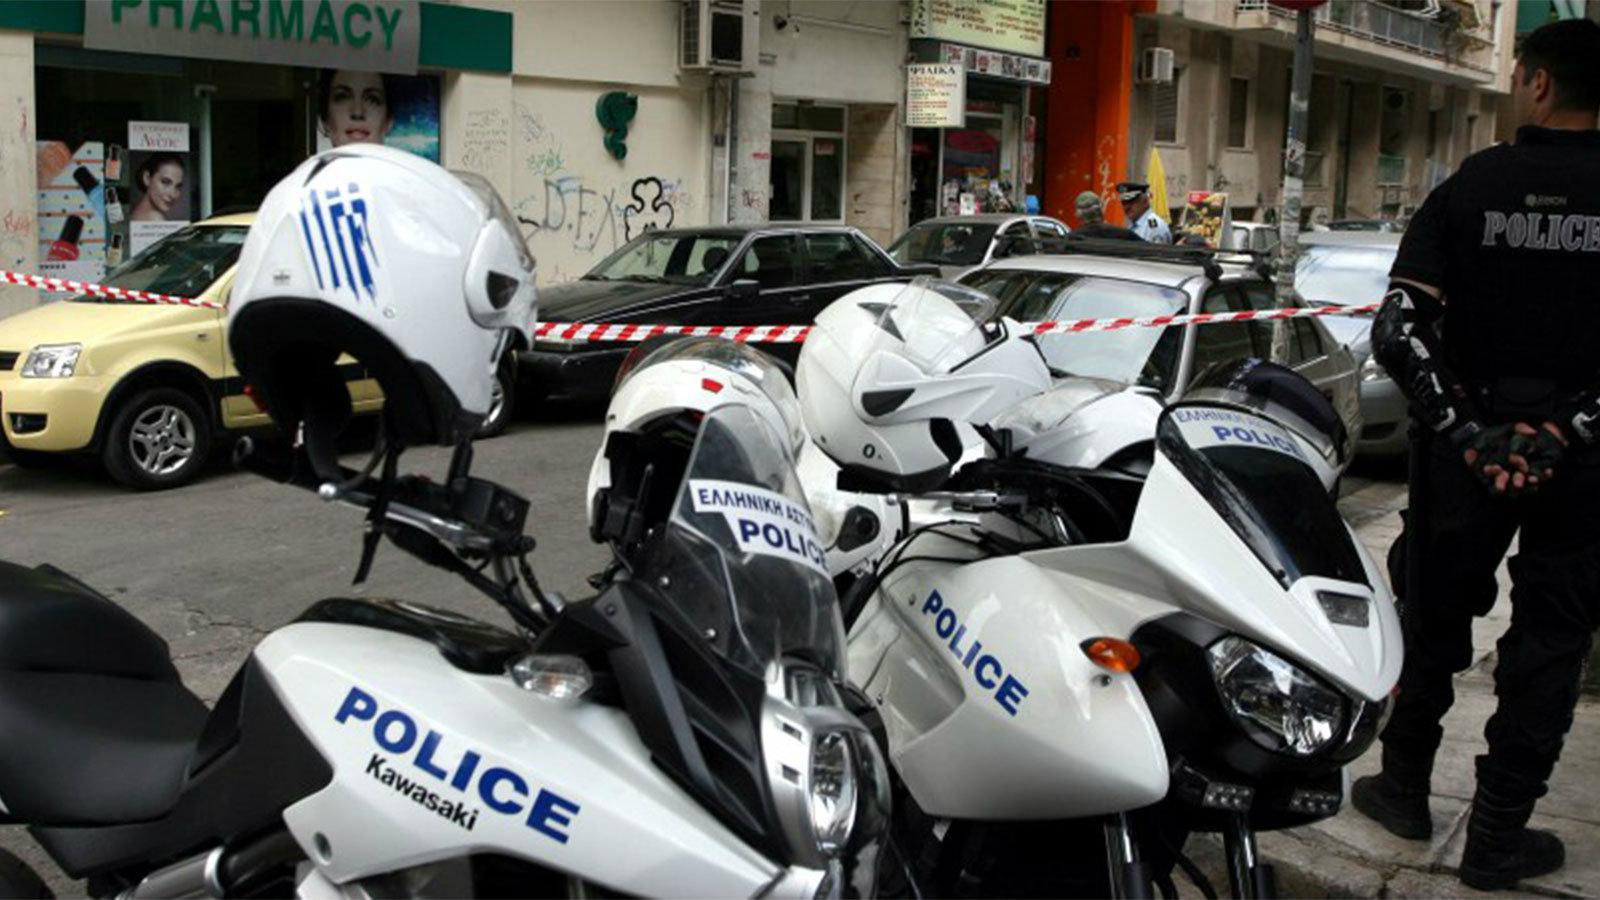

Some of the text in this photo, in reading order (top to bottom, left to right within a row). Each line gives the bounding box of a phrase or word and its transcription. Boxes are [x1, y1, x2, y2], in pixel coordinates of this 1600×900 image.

[110, 0, 402, 49] PHARMACY
[1481, 210, 1600, 251] POLICE
[697, 488, 784, 517] ΕΛΛΗΝΙΚΗ
[922, 589, 1029, 717] POLICE
[334, 686, 581, 844] POLICE
[365, 753, 479, 831] Kawasaki
